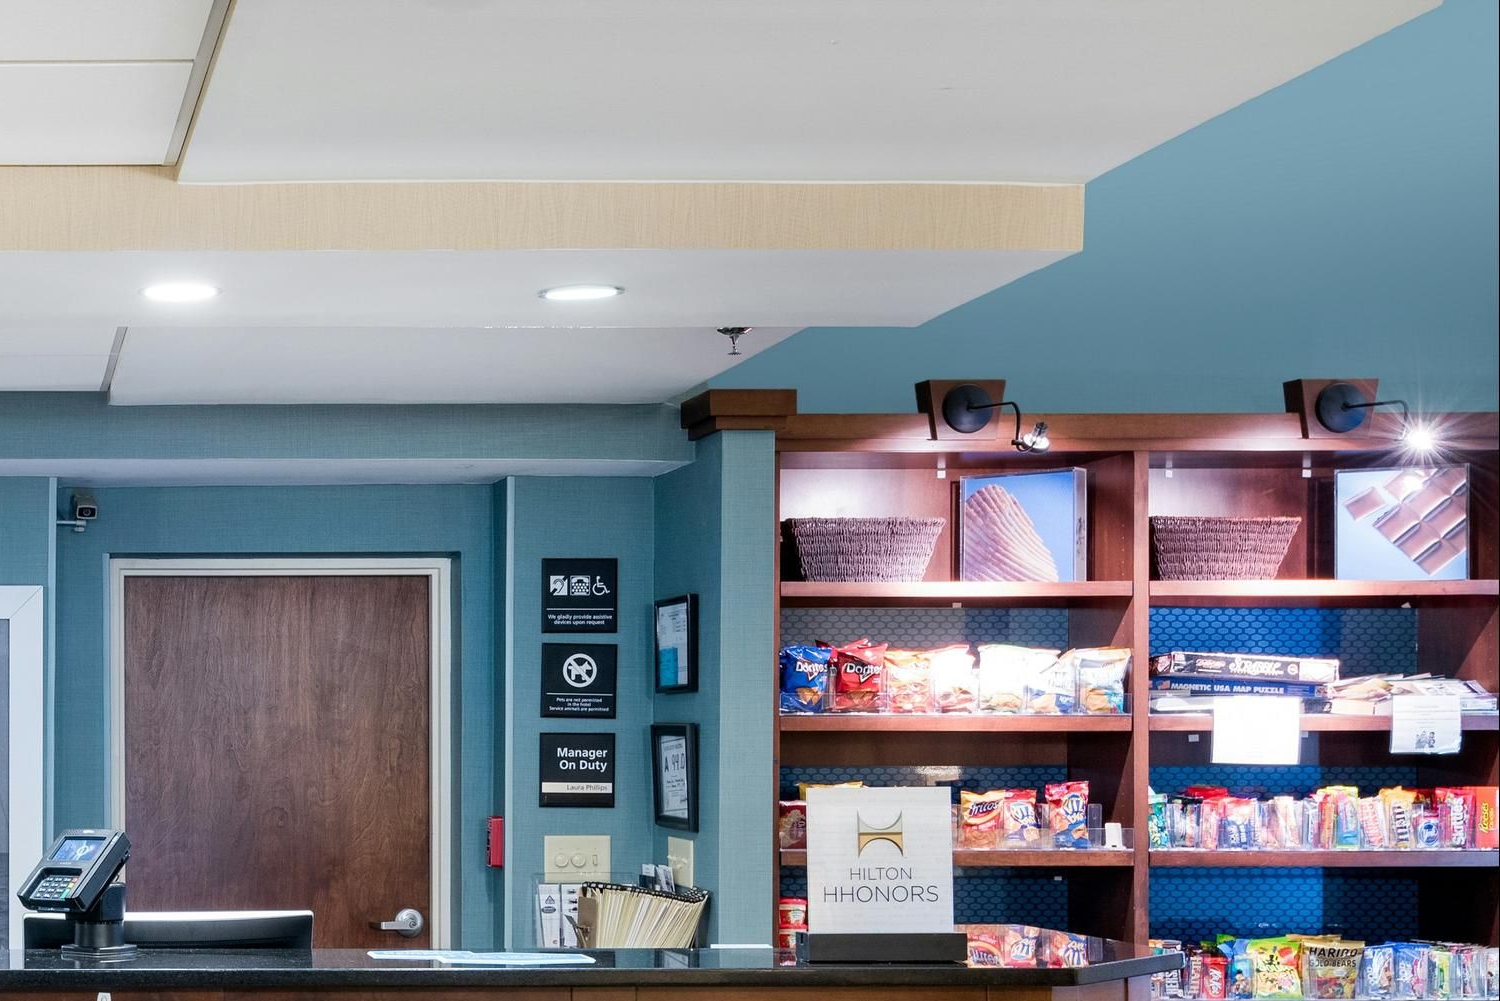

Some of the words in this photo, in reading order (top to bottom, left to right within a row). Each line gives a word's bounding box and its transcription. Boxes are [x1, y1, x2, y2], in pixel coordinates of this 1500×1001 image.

[795, 661, 828, 673] Doritos
[1170, 683, 1212, 692] MAGNETIC
[1213, 684, 1231, 693] USA
[1232, 685, 1252, 693] MAP
[1253, 686, 1285, 694] PUZZLE
[556, 747, 608, 760] Manager
[560, 759, 576, 770] On
[579, 759, 608, 773] Duty
[566, 784, 585, 792] Laura
[850, 867, 913, 881] HILTON
[823, 885, 940, 904] HHONORS
[1309, 946, 1359, 958] HARIBO
[1309, 959, 1330, 968] GOLD
[1331, 959, 1357, 968] BEARS
